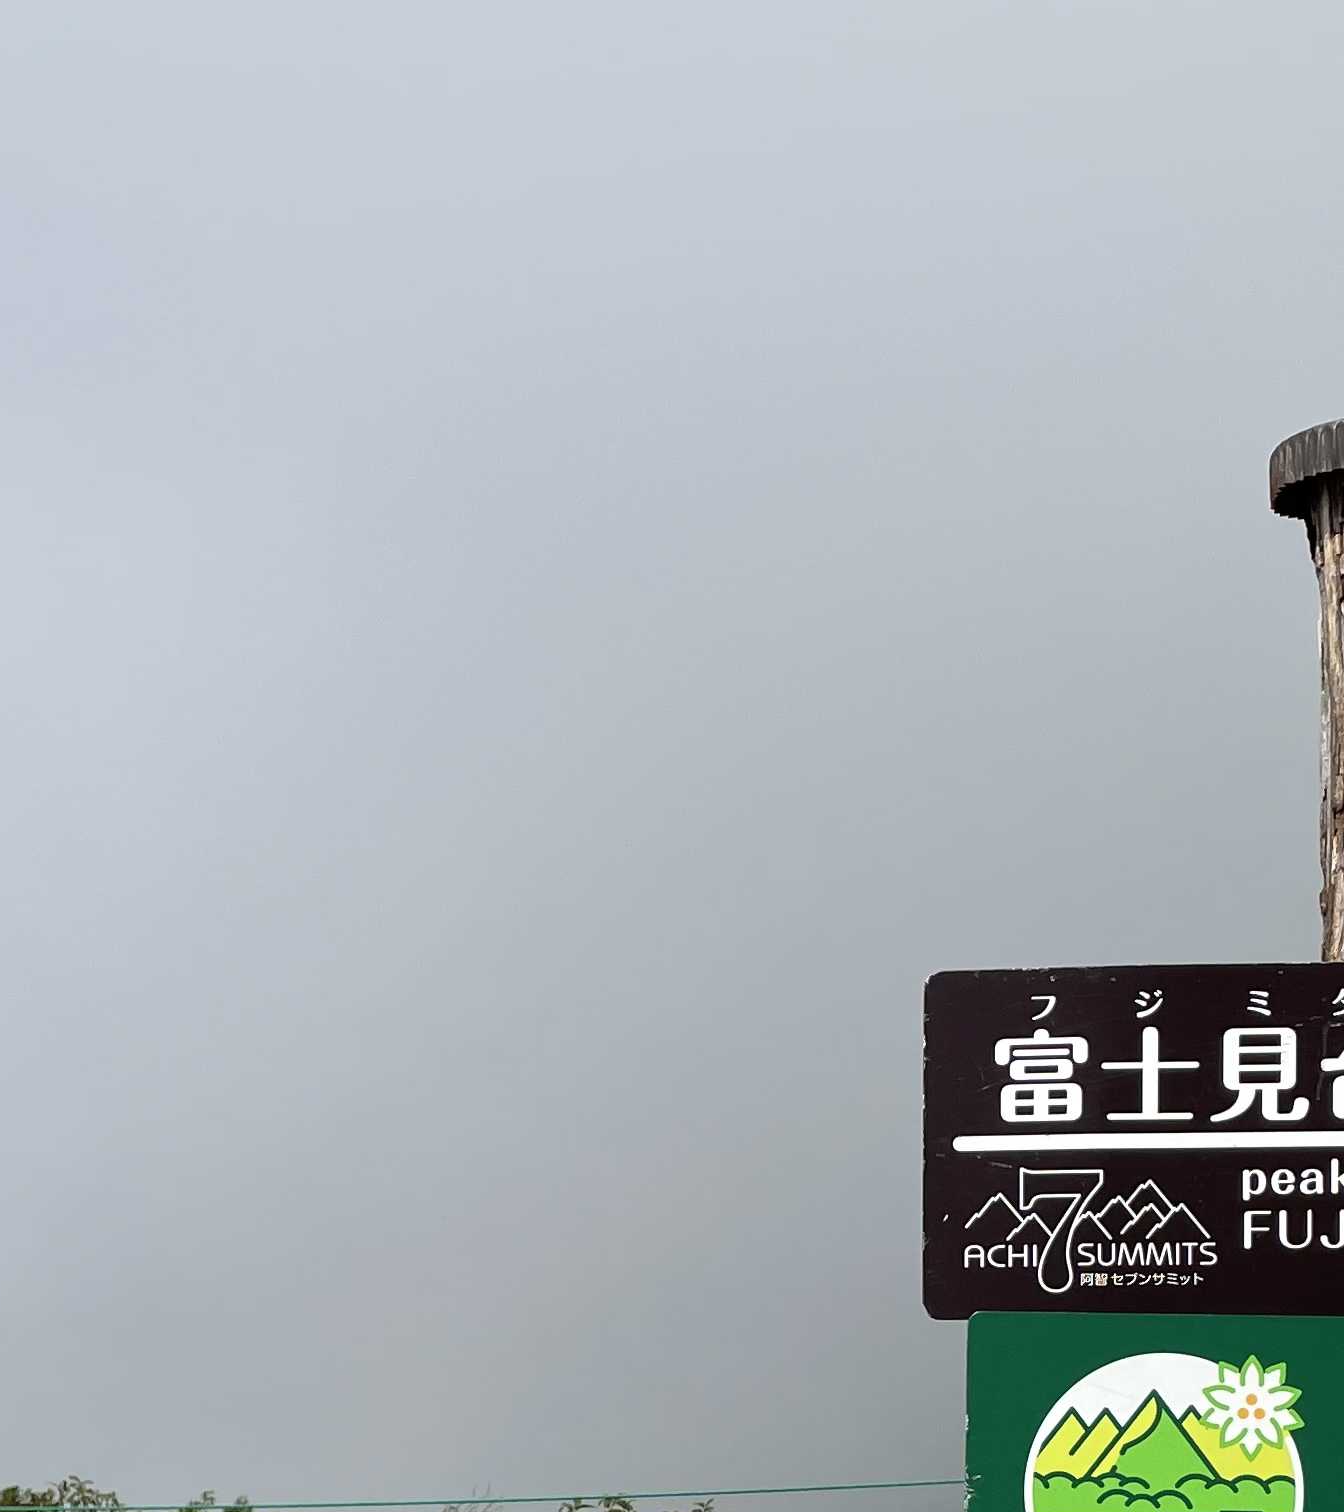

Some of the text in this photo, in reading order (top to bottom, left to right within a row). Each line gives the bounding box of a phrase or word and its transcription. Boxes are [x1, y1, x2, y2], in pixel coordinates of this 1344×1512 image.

[964, 1167, 1217, 1293] ACHI 7 SUMMITS
